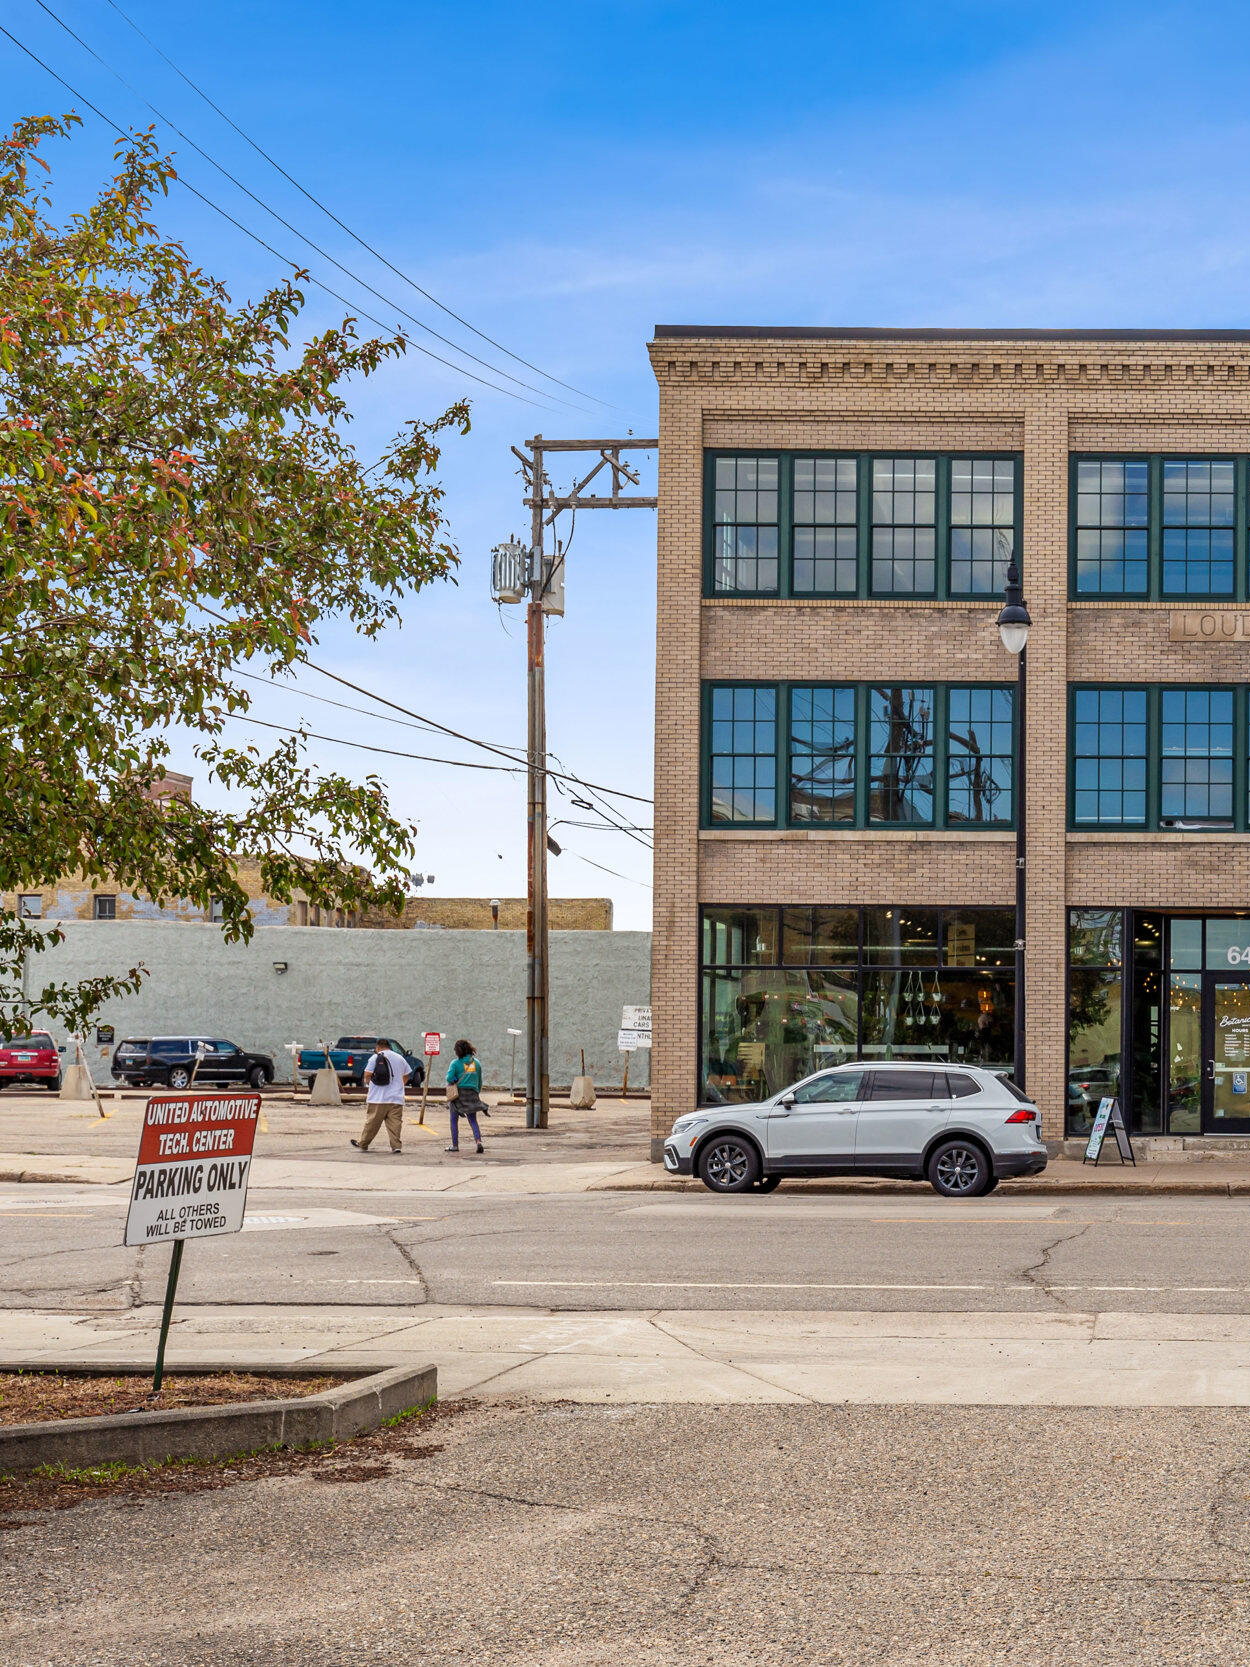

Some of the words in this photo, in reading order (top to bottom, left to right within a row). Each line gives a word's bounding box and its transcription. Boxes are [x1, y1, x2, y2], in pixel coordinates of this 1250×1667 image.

[147, 1102, 190, 1126] UNITED
[190, 1098, 259, 1122] AUTOMOTIVE
[159, 1132, 190, 1156] TECH.
[193, 1128, 235, 1152] CENTER
[134, 1164, 204, 1201] PARKING
[207, 1160, 248, 1192] ONLY
[156, 1209, 176, 1222] ALL
[179, 1202, 220, 1219] OTHERS
[146, 1224, 170, 1238] WILL
[173, 1221, 187, 1234] BE
[190, 1216, 227, 1232] TOWED
